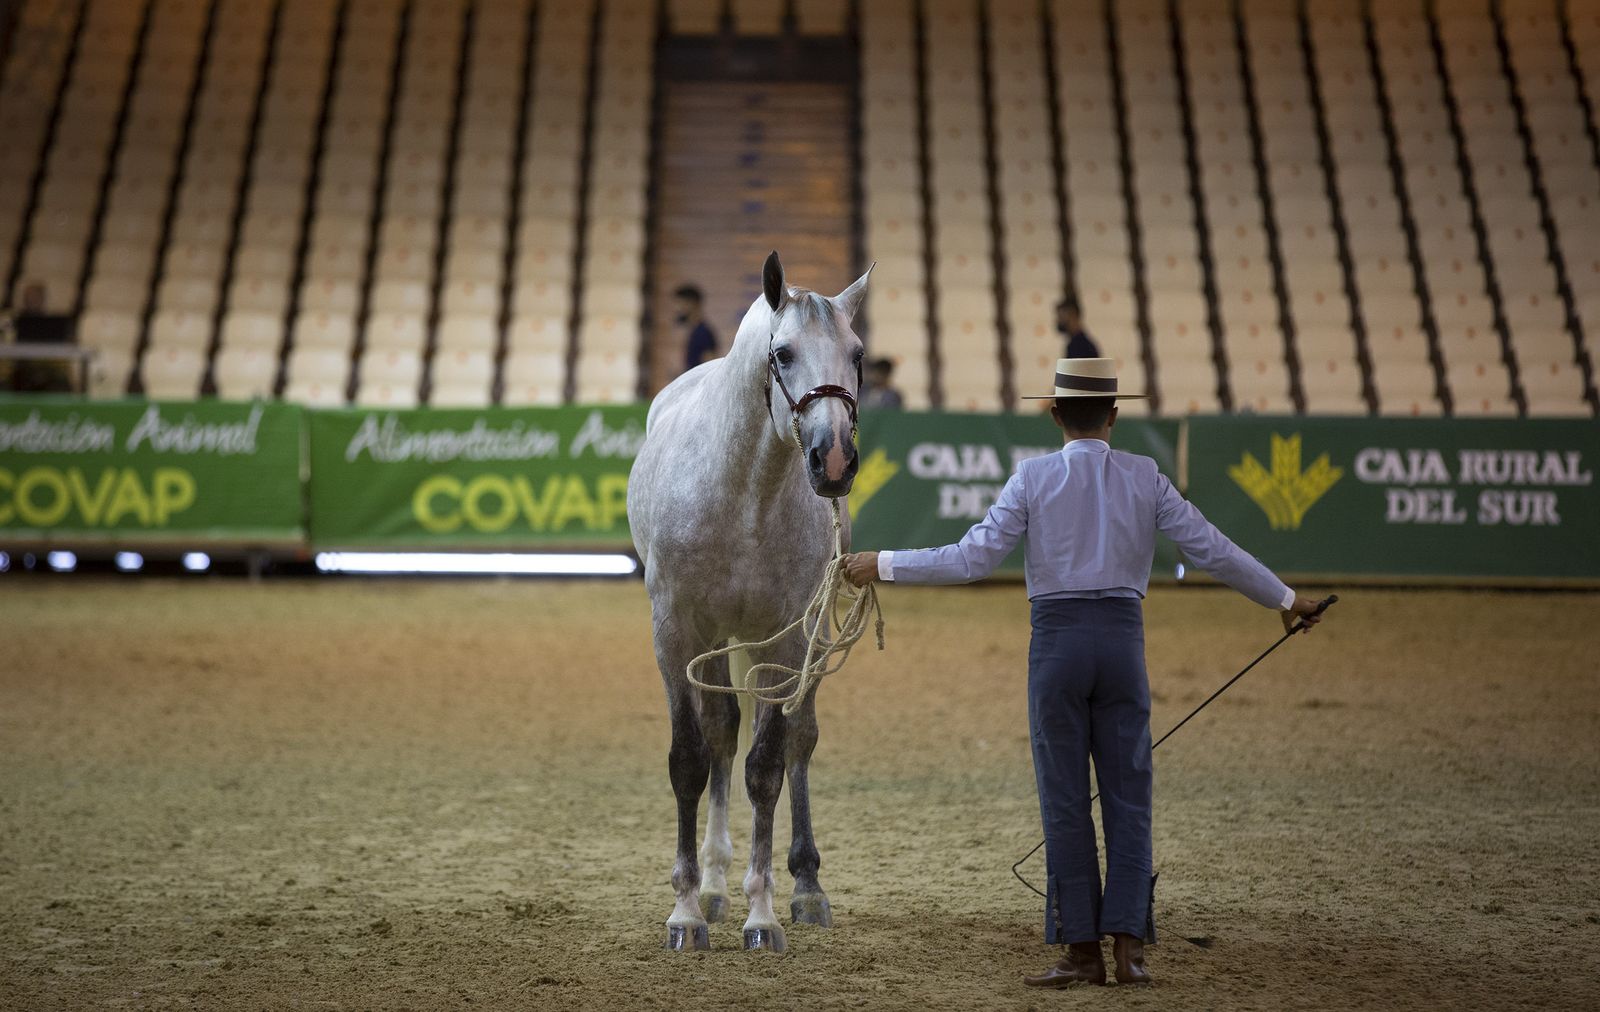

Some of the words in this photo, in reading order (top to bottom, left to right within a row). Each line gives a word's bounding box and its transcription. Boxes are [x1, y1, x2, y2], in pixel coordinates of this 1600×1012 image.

[126, 399, 264, 454] Animal
[907, 442, 1004, 480] CAJA
[1354, 448, 1450, 485] CAJA
[1458, 450, 1592, 485] RURAL
[1386, 489, 1467, 524] DEL
[1477, 490, 1561, 525] SUR
